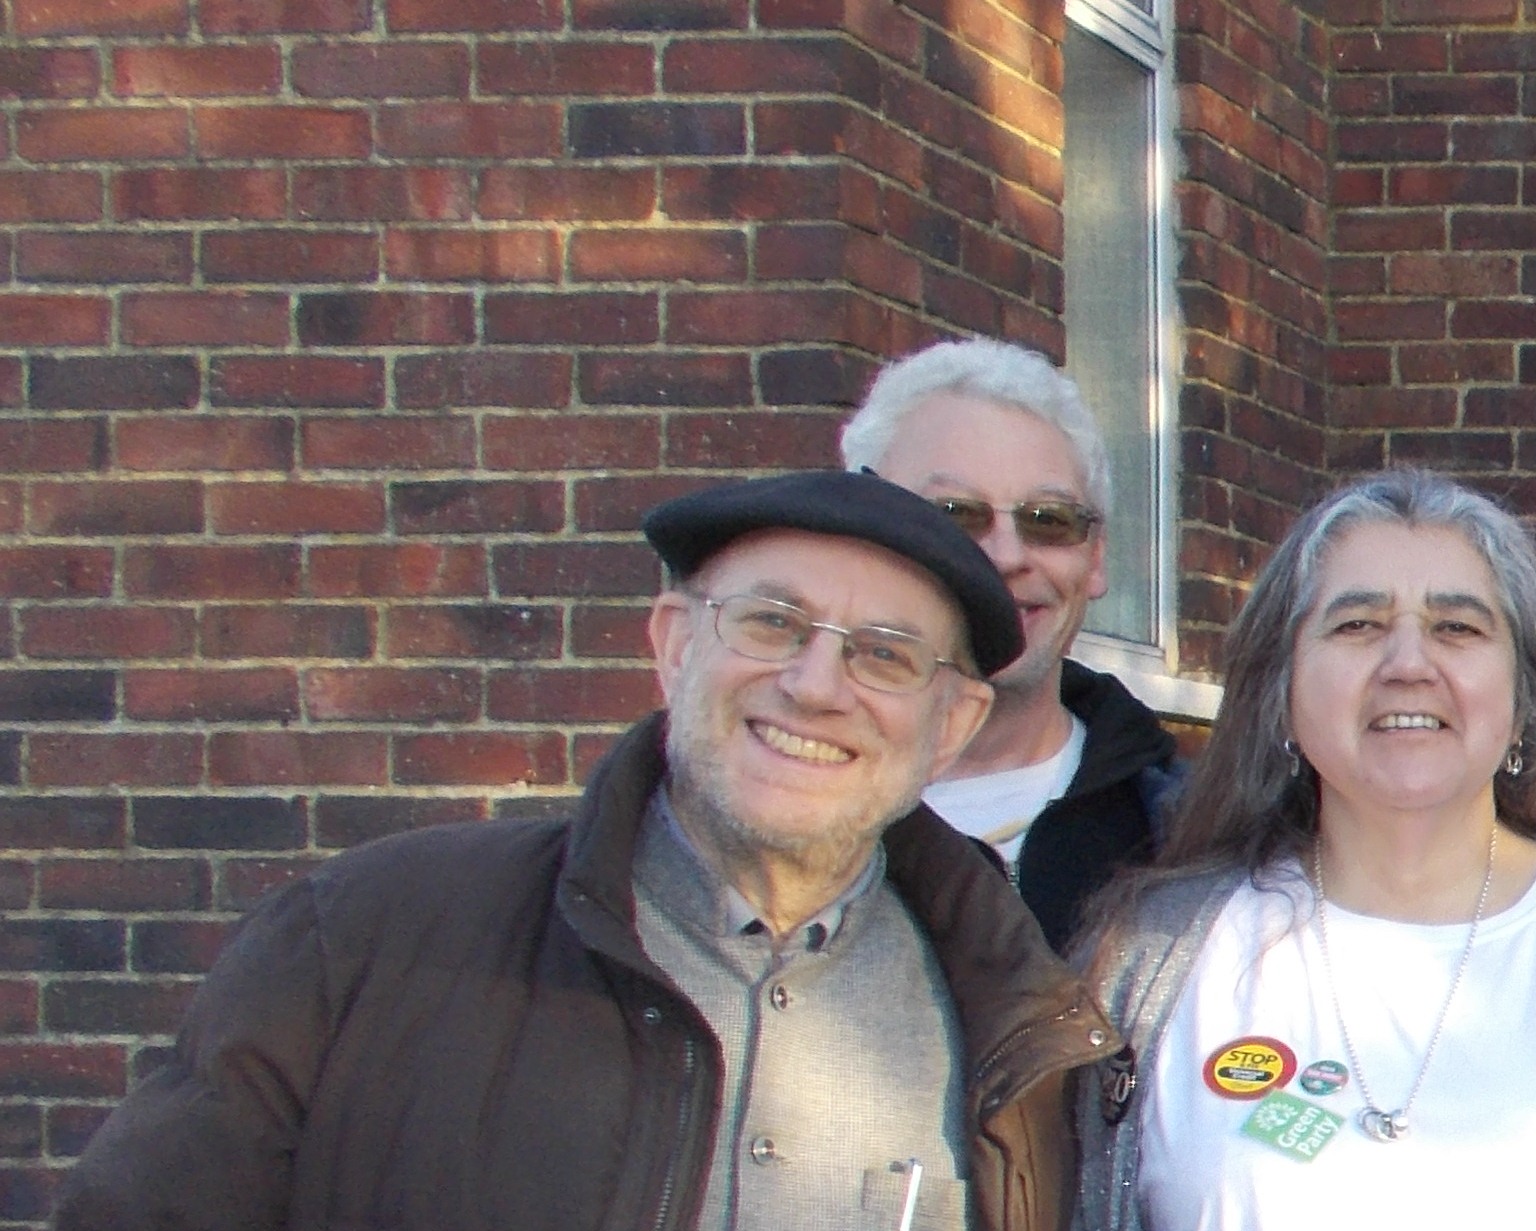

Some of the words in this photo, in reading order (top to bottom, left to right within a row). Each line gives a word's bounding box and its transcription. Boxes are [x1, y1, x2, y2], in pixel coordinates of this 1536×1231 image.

[1228, 1050, 1279, 1065] STOP
[1277, 1106, 1322, 1147] Green
[1296, 1115, 1339, 1156] Party
